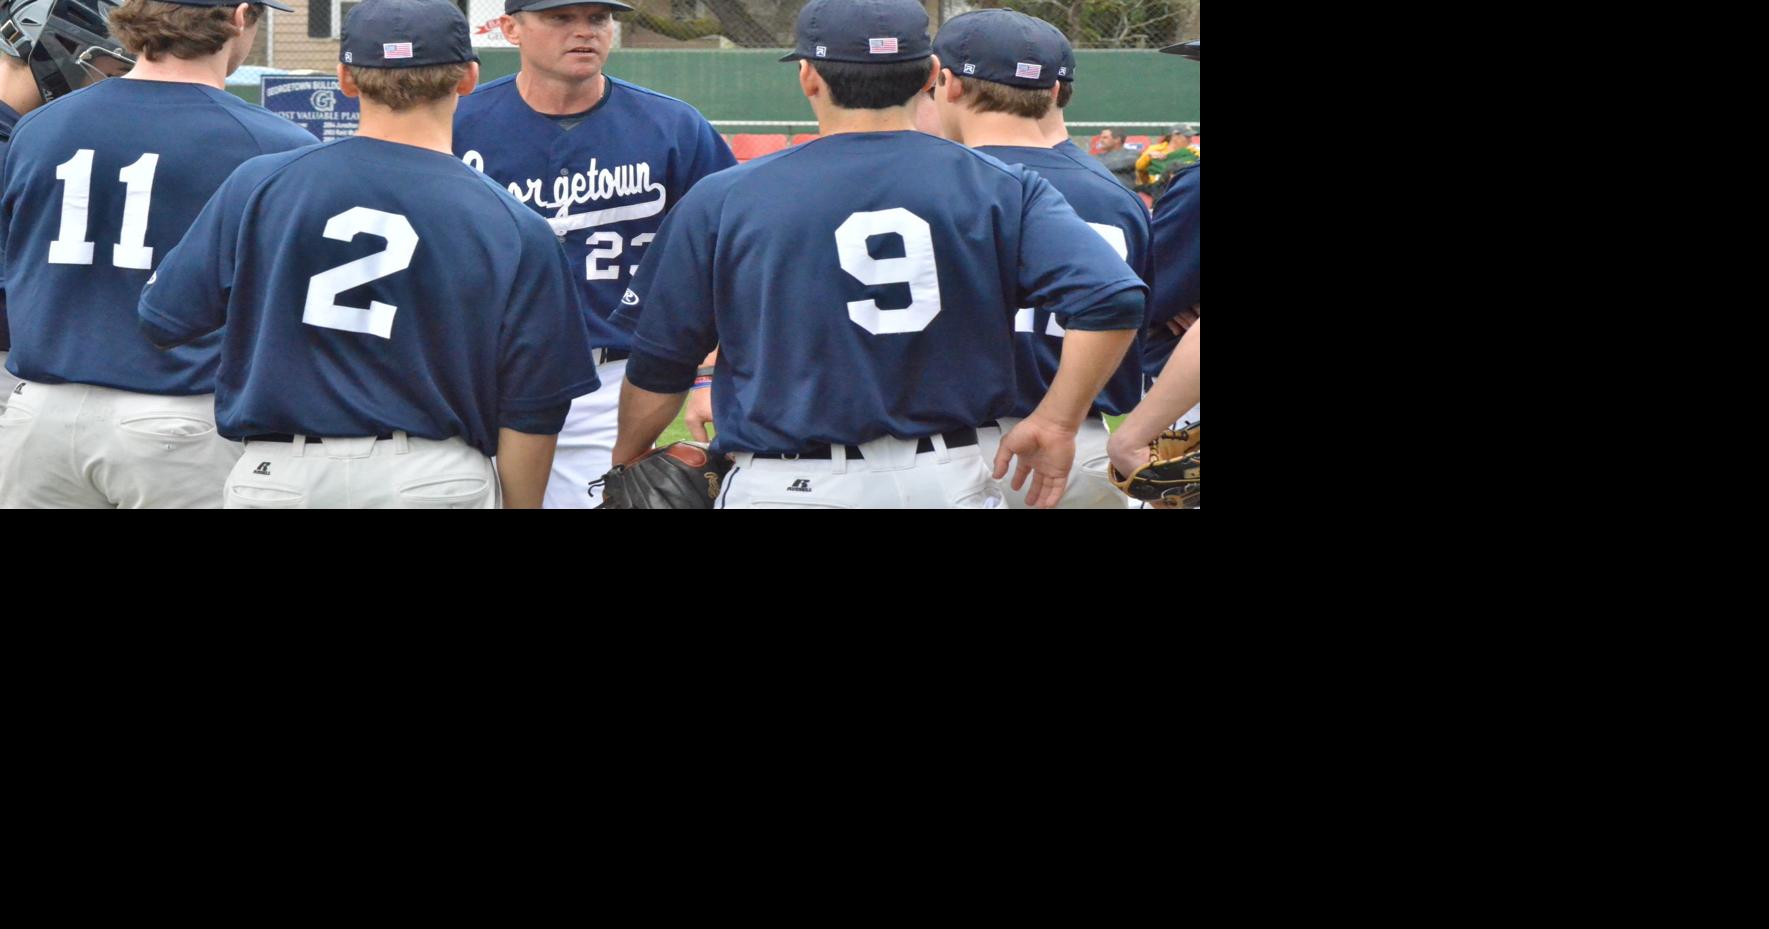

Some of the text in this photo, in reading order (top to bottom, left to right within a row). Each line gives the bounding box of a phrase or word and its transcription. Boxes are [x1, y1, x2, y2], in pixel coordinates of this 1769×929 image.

[275, 111, 295, 120] OST
[296, 111, 339, 120] VALUABLE
[48, 149, 159, 270] 11
[834, 207, 943, 336] 9
[302, 206, 419, 339] 2
